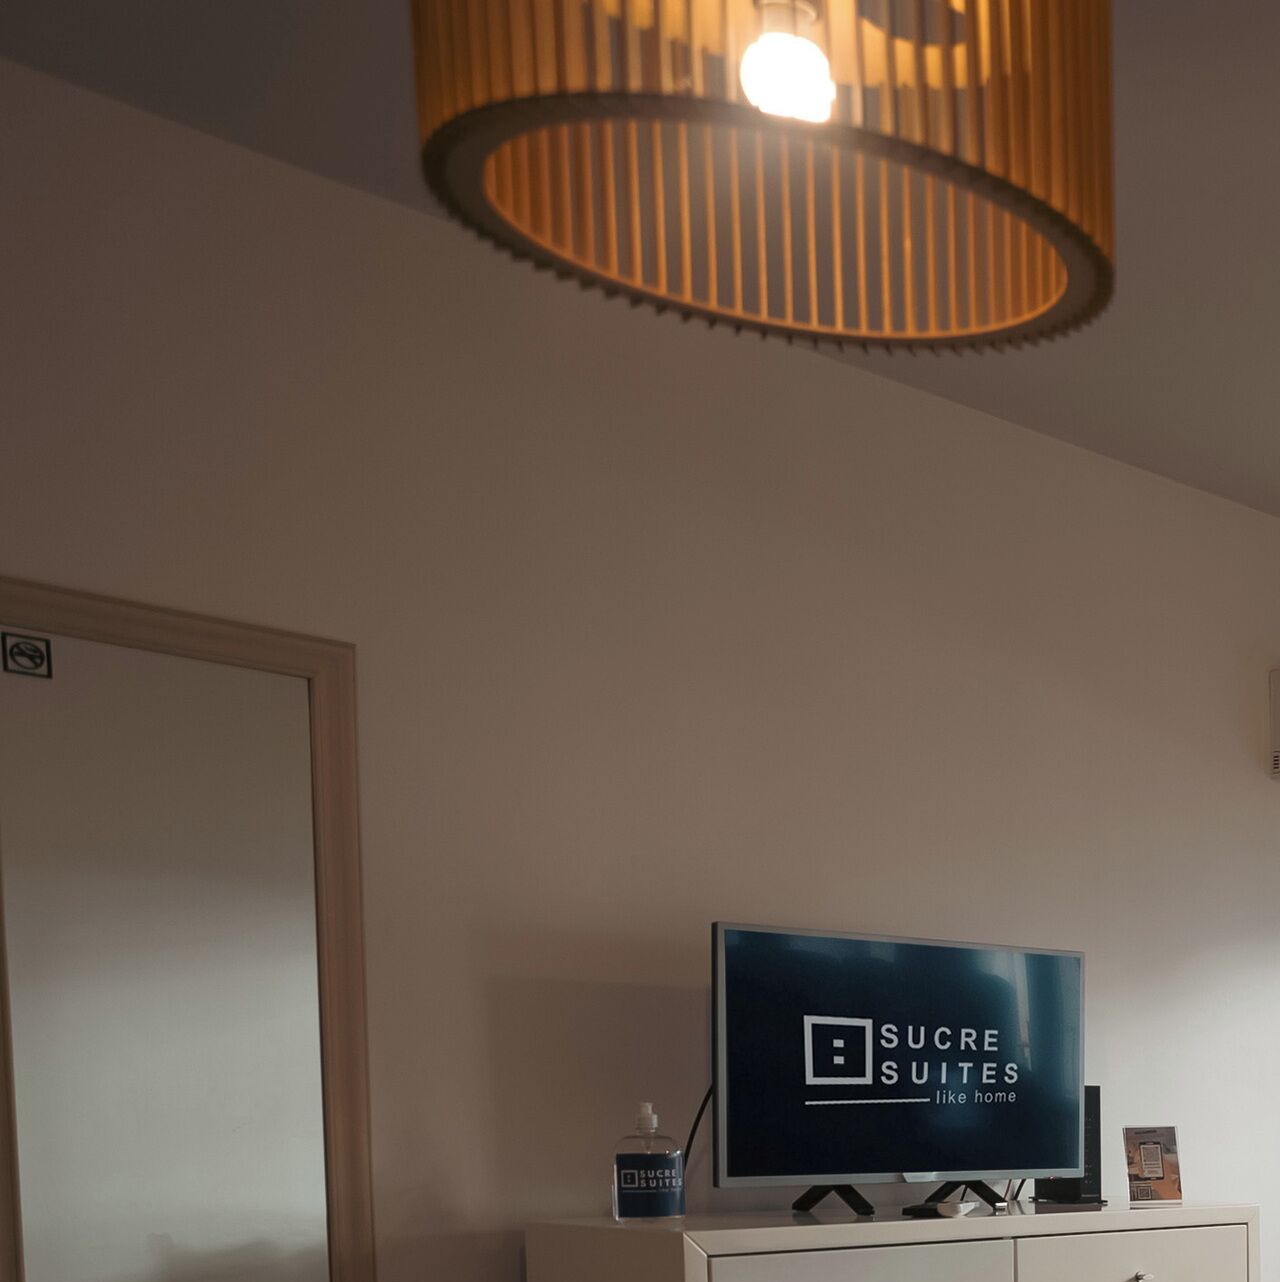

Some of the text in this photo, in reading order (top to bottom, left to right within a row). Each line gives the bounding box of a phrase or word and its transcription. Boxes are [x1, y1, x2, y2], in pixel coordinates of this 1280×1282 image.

[880, 1023, 999, 1052] SUCRE
[880, 1060, 1019, 1085] SUITES
[936, 1090, 1017, 1104] like home
[639, 1168, 678, 1178] SUCRE
[640, 1178, 683, 1187] SUITES
